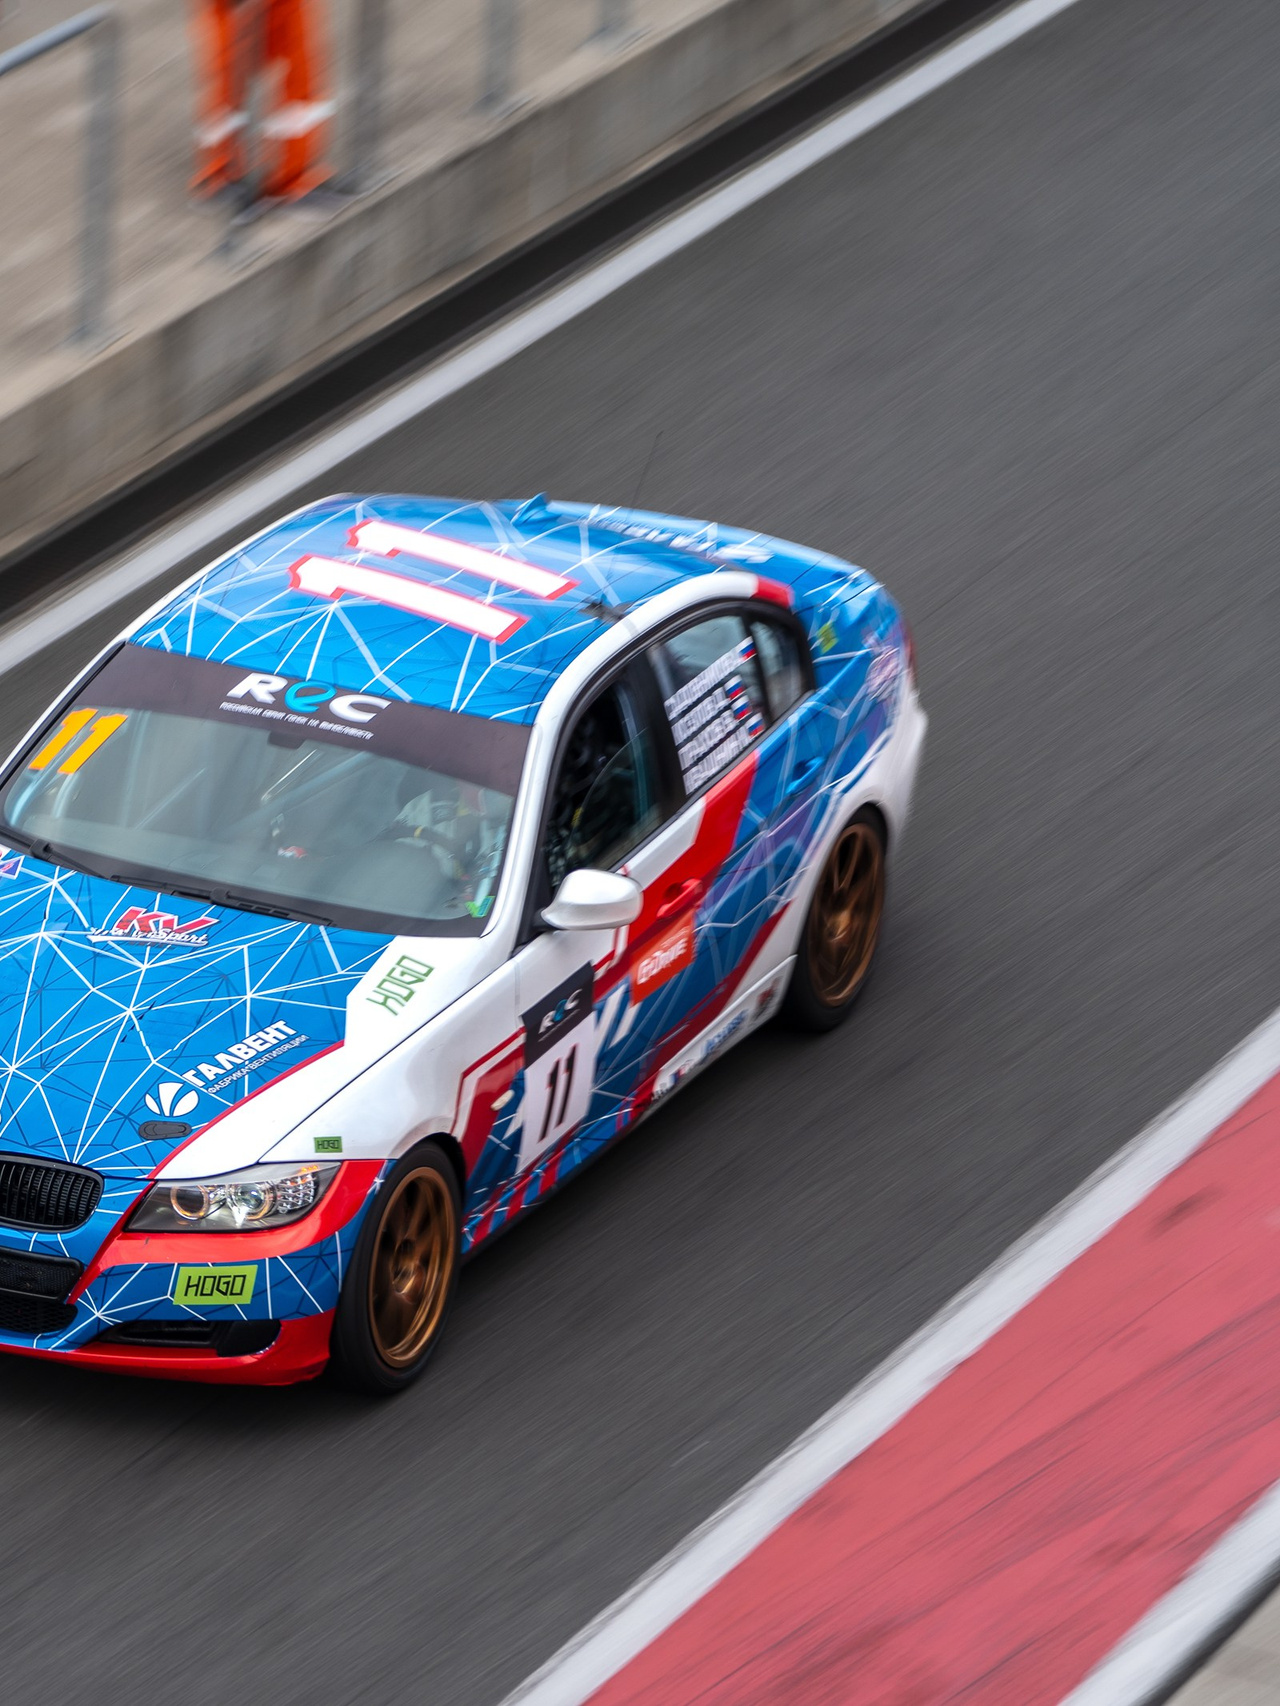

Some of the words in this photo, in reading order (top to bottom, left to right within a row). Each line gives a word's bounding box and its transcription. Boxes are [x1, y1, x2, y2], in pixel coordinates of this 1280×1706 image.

[286, 518, 581, 646] 11
[27, 708, 129, 775] 11
[365, 954, 435, 1016] HOGO
[182, 1020, 297, 1088] ГАЛВЕНТ
[537, 1043, 578, 1144] 11
[184, 1274, 247, 1297] HOGO
